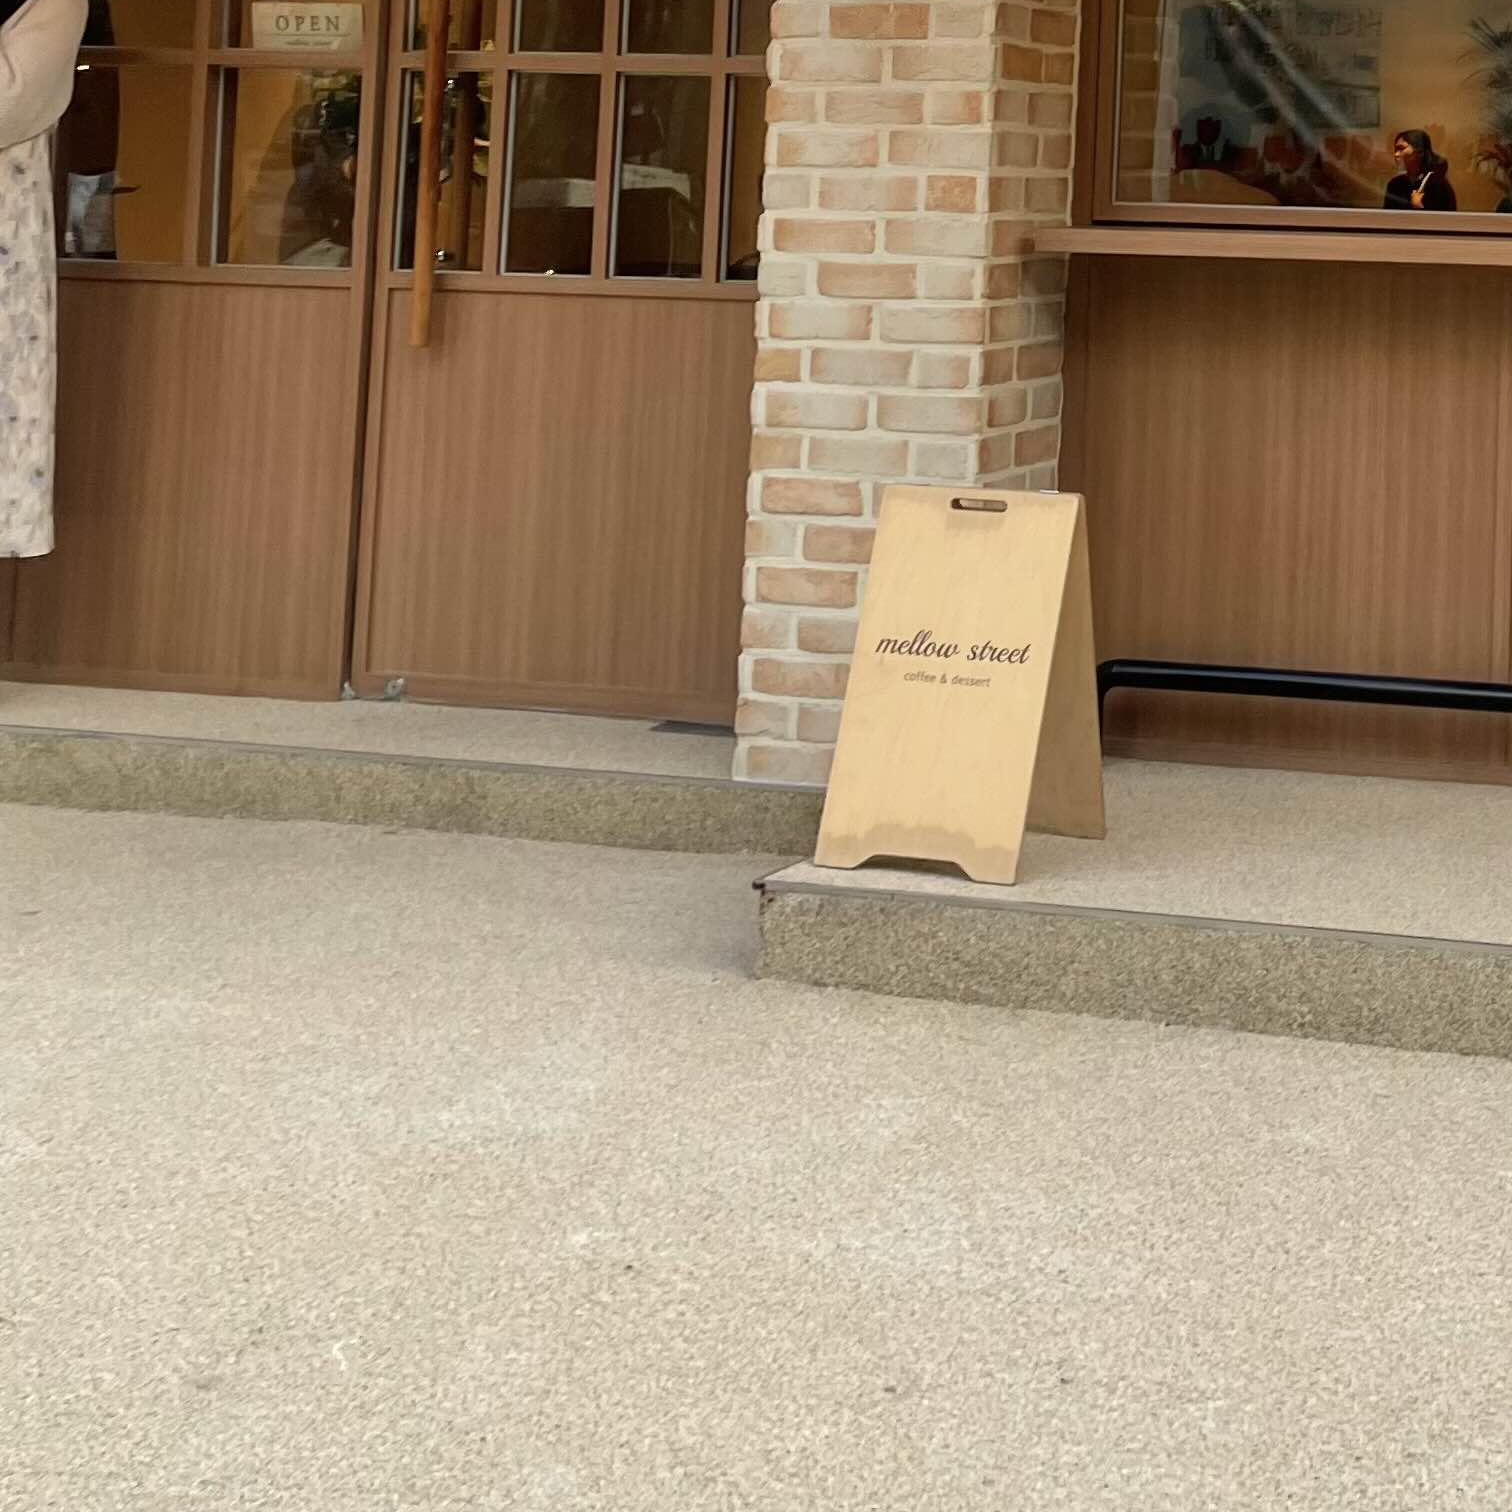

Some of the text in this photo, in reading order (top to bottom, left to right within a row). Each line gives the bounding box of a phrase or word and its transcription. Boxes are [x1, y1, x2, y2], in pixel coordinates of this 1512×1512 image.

[275, 15, 341, 32] OPEN
[875, 629, 1032, 665] mellow street
[903, 671, 937, 684] coffee
[951, 673, 991, 688] dessert
